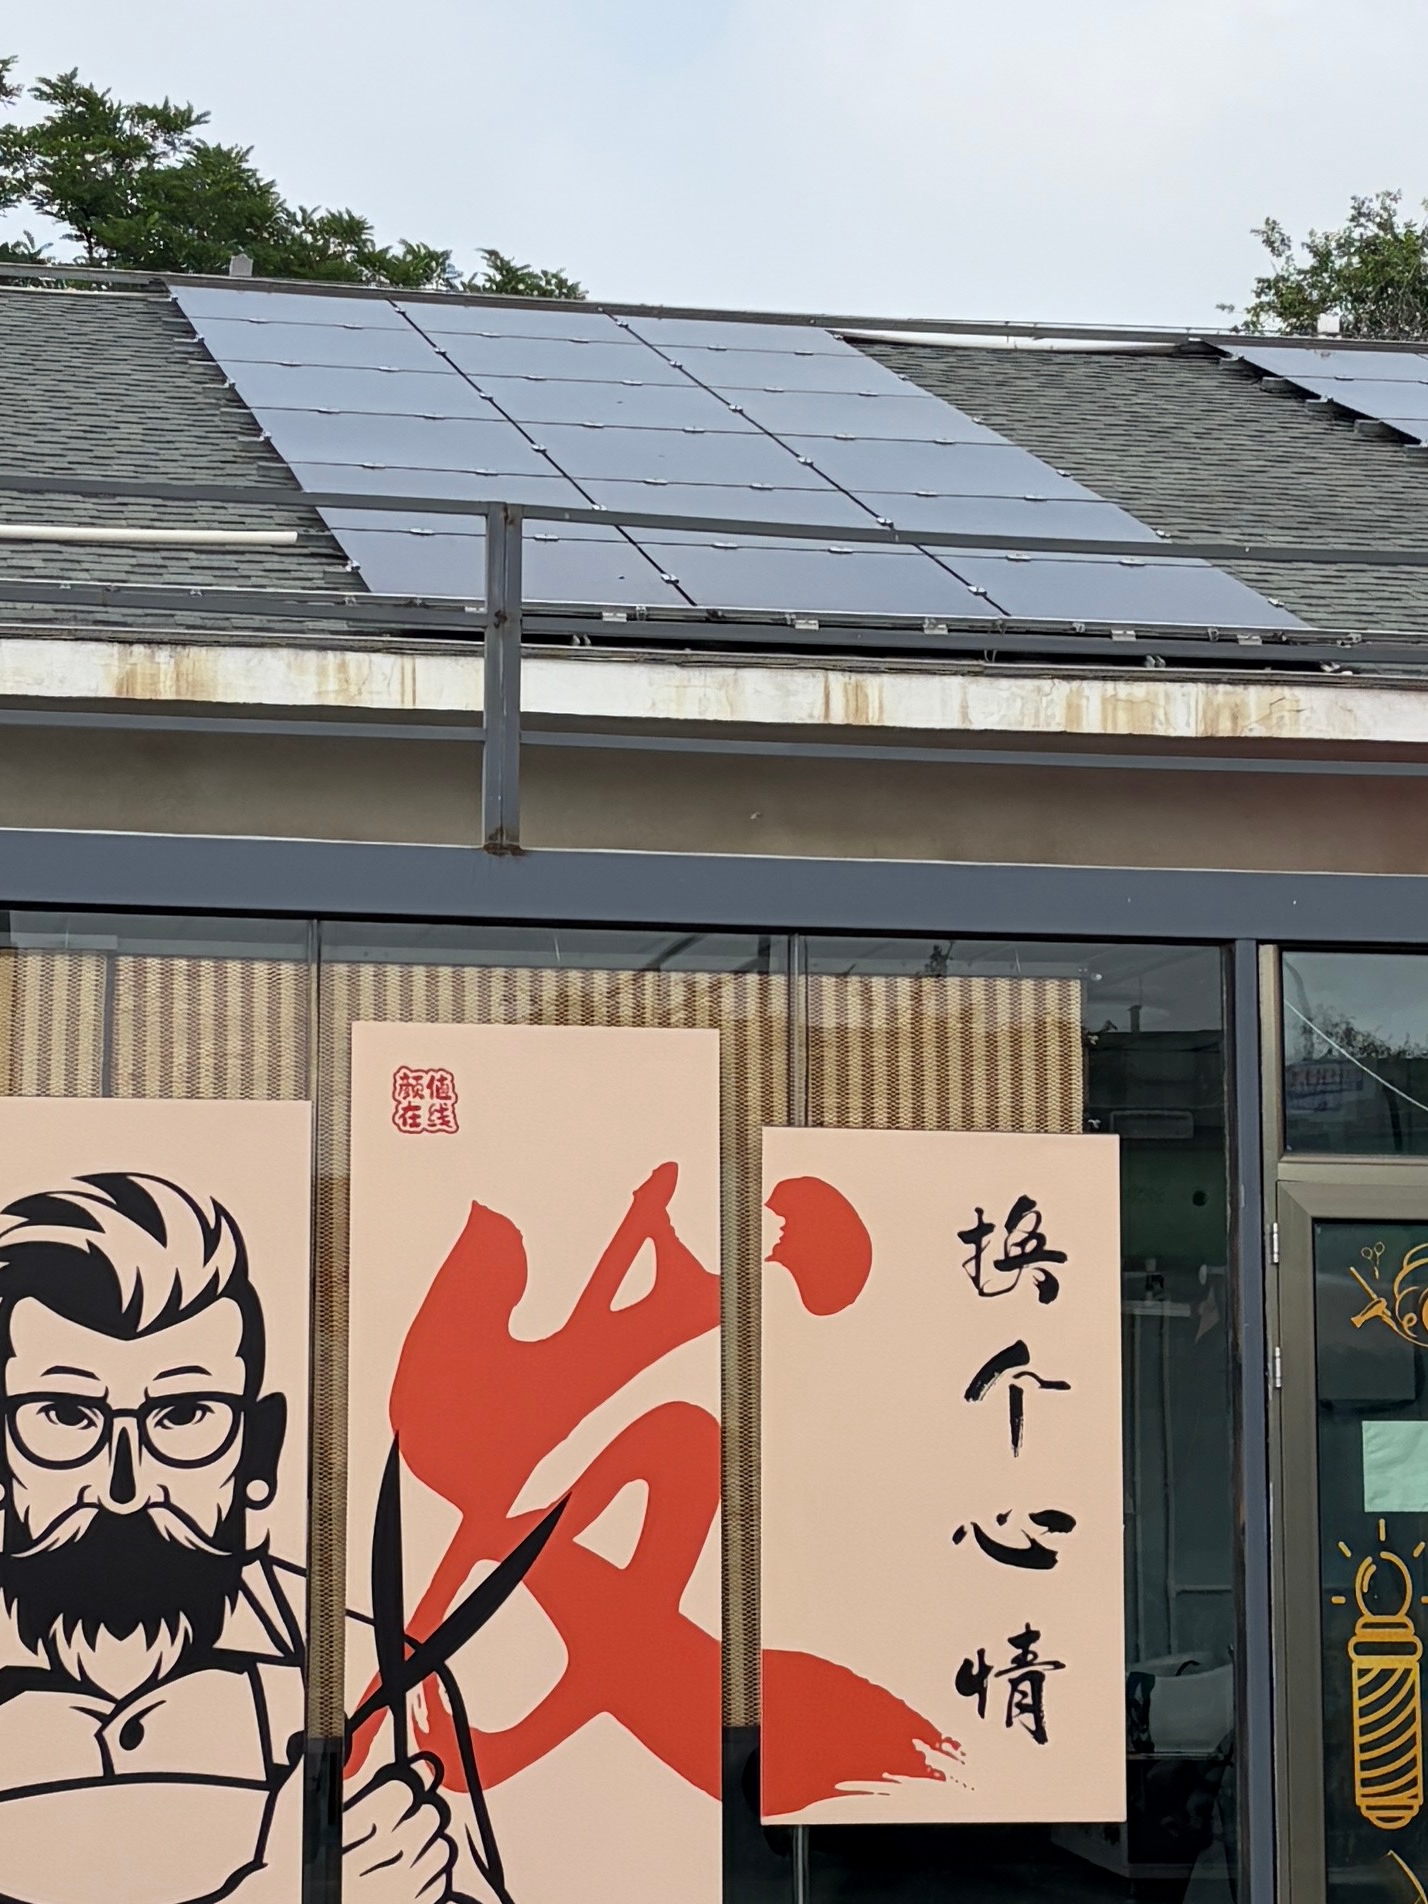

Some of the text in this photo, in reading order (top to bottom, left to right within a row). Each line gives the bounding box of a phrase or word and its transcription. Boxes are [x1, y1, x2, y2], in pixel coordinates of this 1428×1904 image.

[398, 1072, 452, 1100] 颜值
[398, 1100, 453, 1128] 在线
[952, 1194, 1077, 1746] 换个心情
